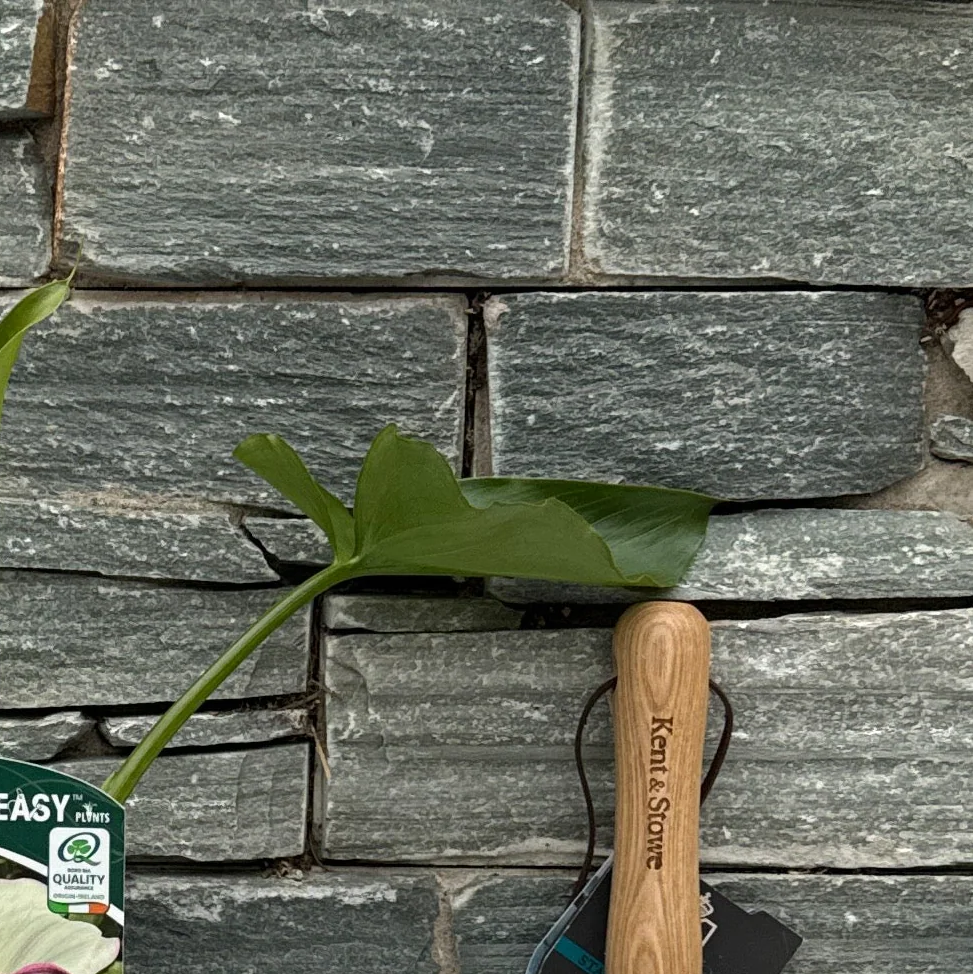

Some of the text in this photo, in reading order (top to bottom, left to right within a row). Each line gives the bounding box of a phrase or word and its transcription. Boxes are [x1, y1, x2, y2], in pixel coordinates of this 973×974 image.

[646, 716, 673, 870] Kent & Stowe
[53, 874, 105, 885] QUALITY
